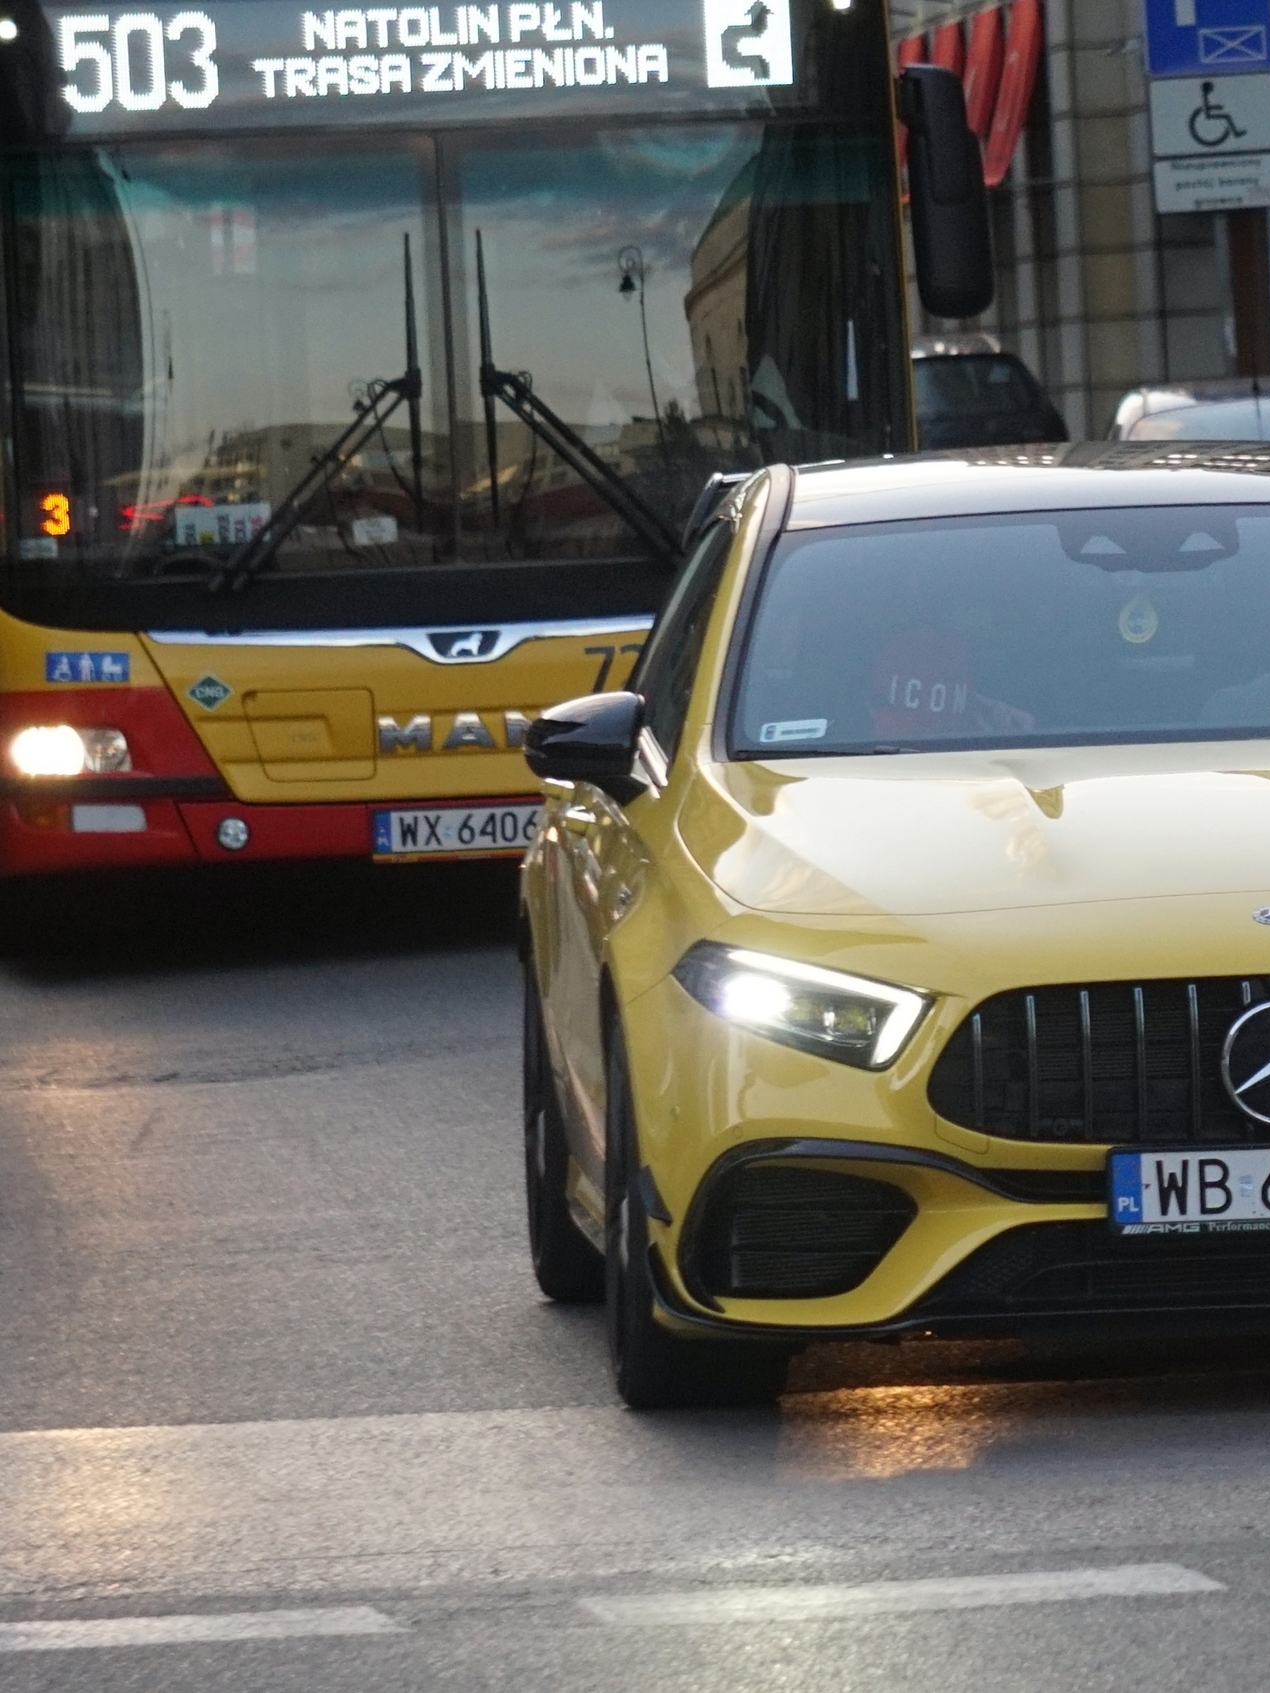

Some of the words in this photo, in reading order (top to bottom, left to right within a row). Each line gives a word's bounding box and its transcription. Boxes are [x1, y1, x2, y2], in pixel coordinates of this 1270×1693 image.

[302, 5, 499, 50] NATOLIN
[505, 1, 615, 42] PŁN.
[58, 11, 219, 113] 503
[252, 54, 412, 98] TRASA
[420, 44, 669, 92] ZMIENIONA
[40, 493, 70, 536] 3
[889, 675, 968, 714] ICON
[399, 814, 443, 848] WX
[1118, 1197, 1140, 1212] PL
[1155, 1157, 1233, 1217] WB
